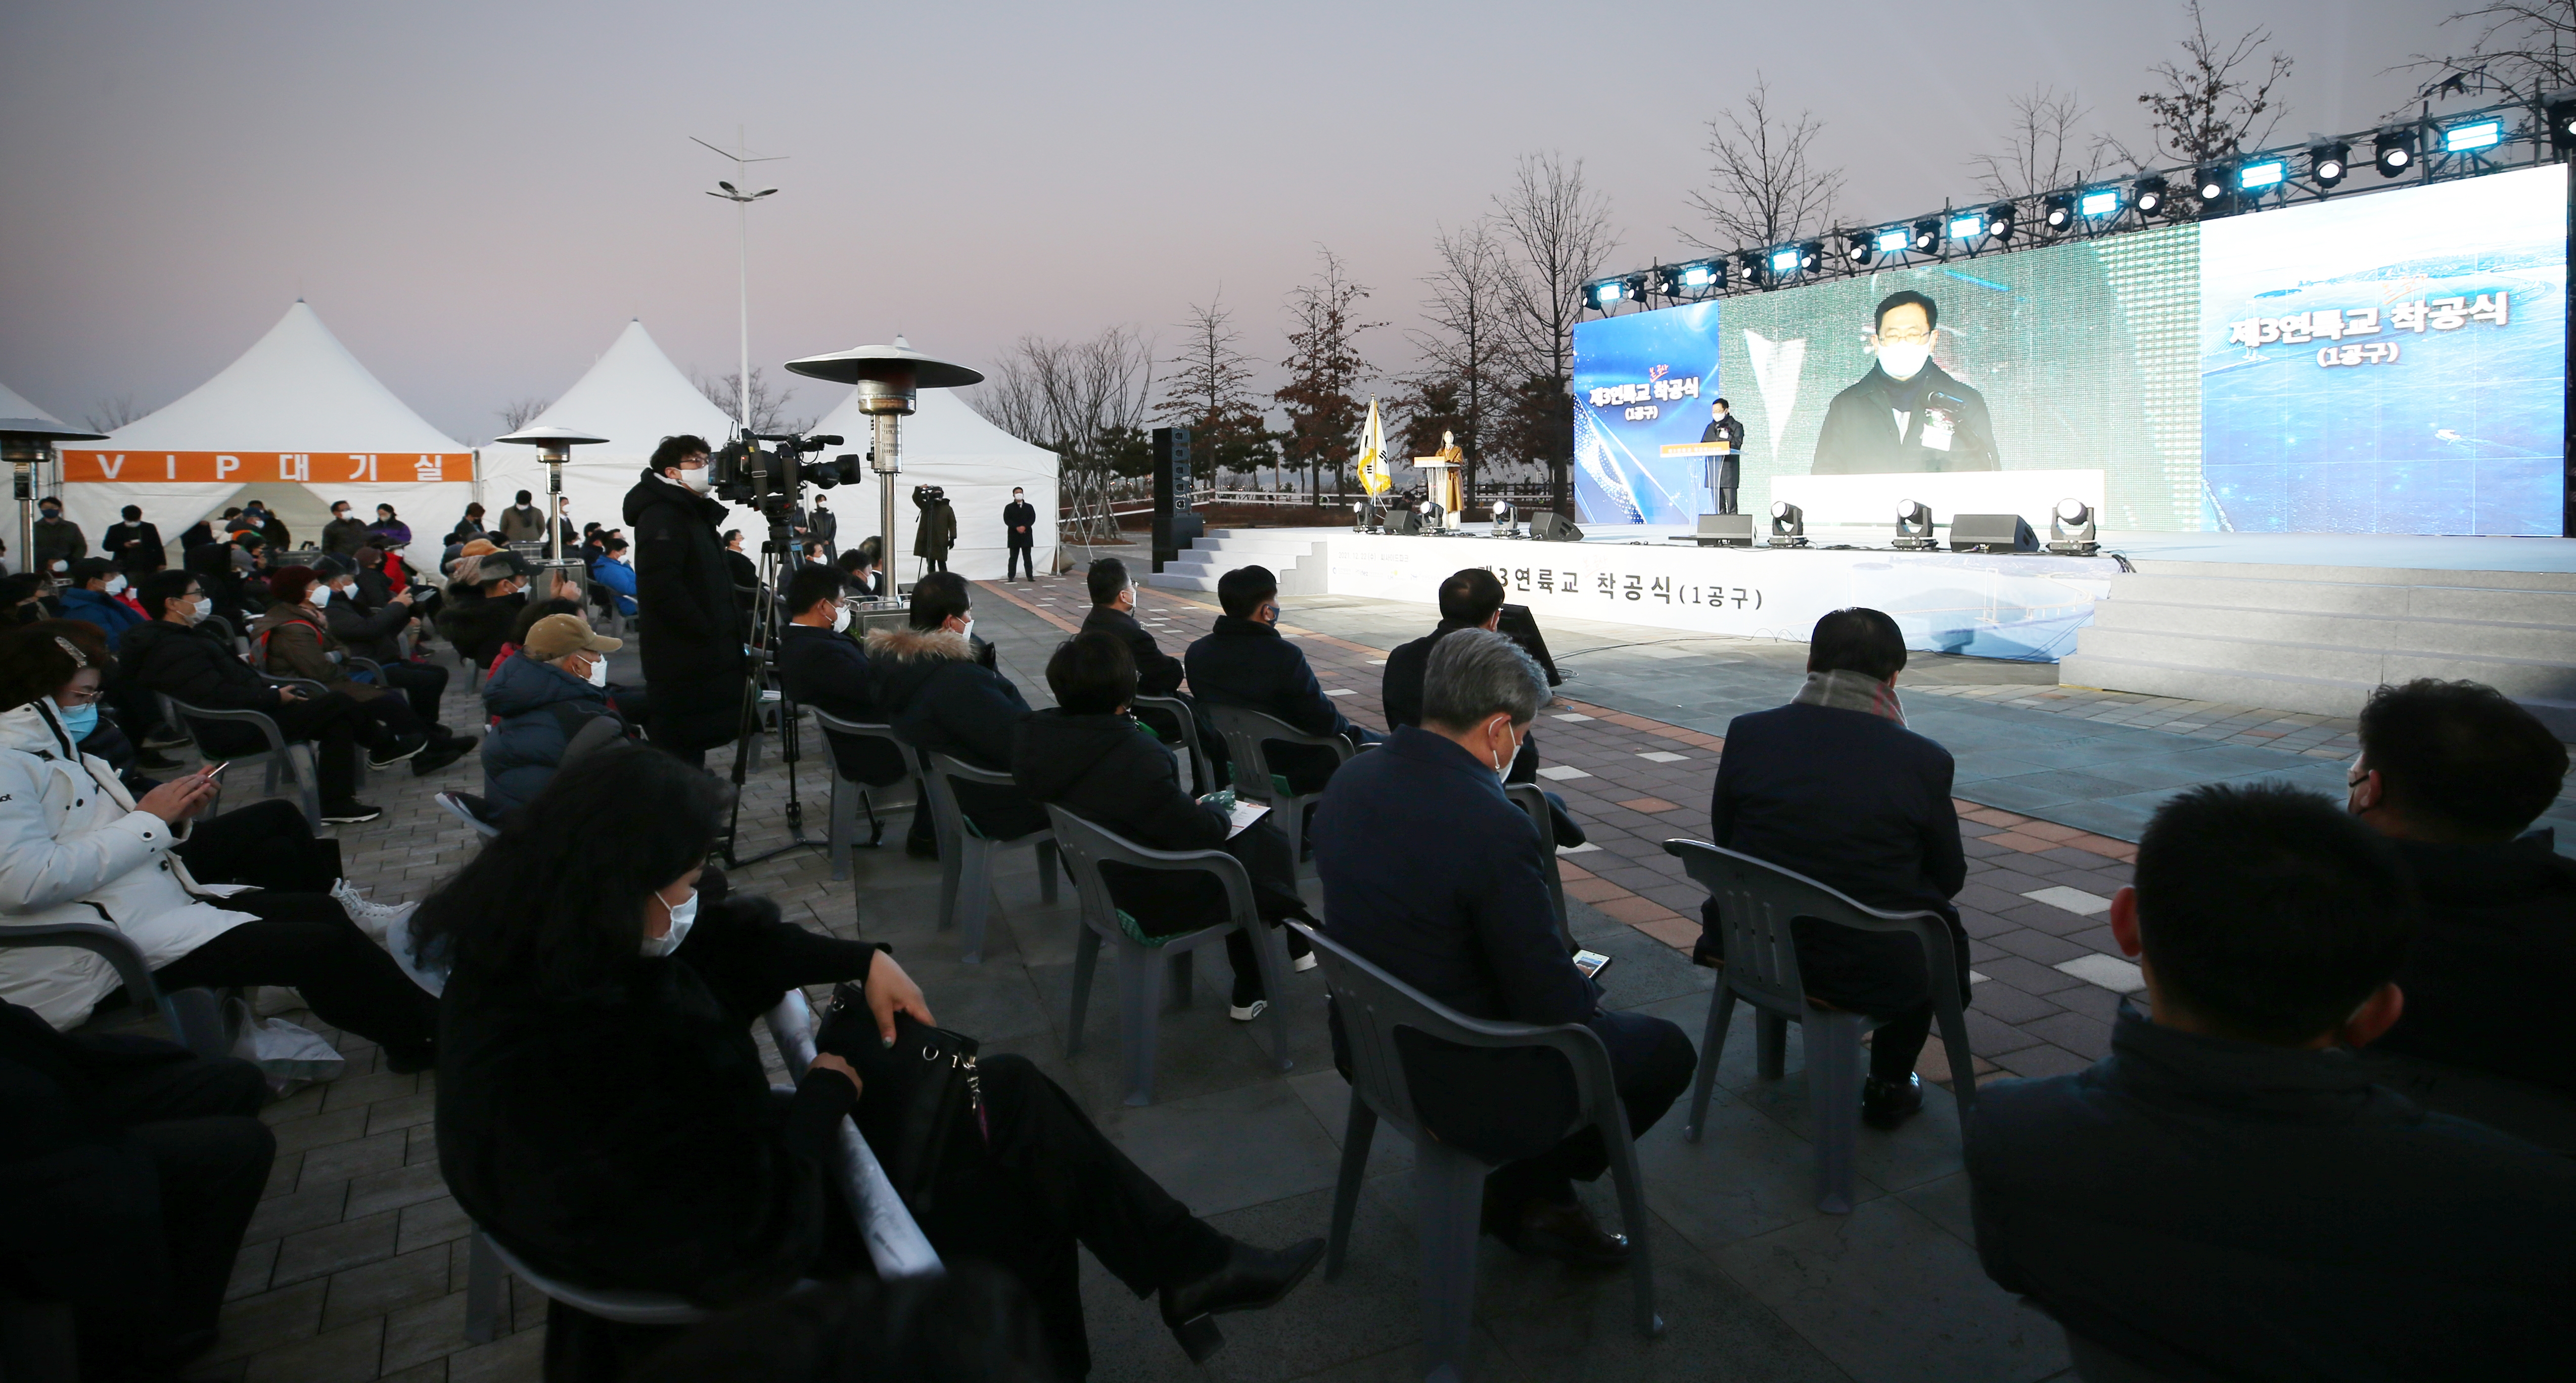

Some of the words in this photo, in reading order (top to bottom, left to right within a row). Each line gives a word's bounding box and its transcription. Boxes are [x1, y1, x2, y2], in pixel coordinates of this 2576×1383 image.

[2229, 307, 2382, 347] 제3연륙교
[2390, 291, 2509, 333] 착공식
[2317, 342, 2399, 367] (1공구)
[1653, 376, 1699, 401] 착공식
[1625, 405, 1659, 421] (1공구)
[1381, 554, 1408, 562] 씨사이드파크
[1478, 565, 1579, 594] 3연륙교
